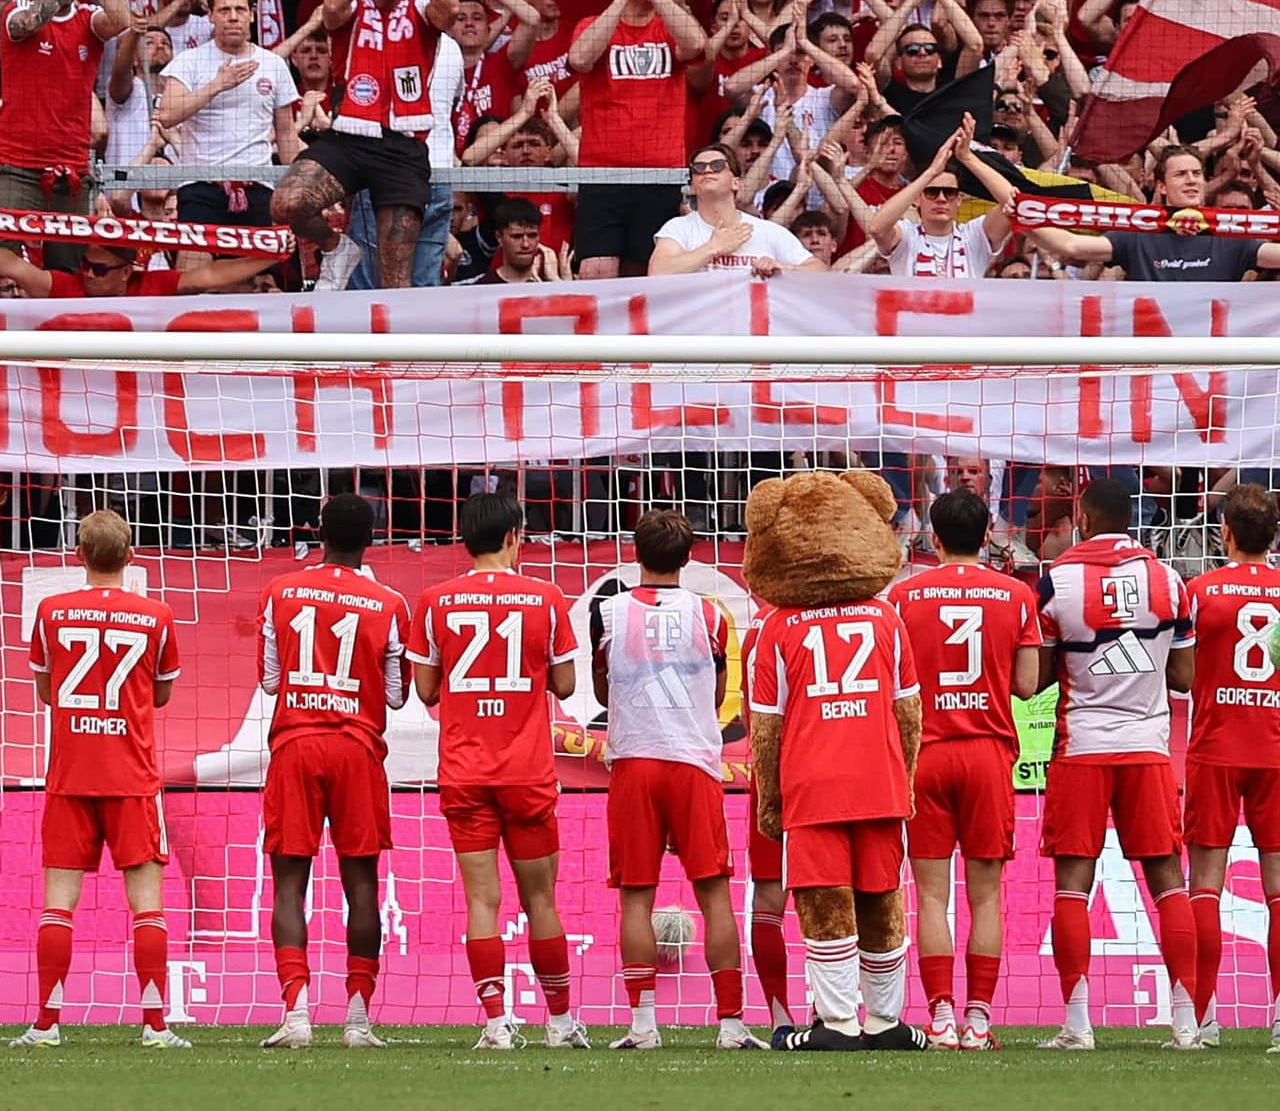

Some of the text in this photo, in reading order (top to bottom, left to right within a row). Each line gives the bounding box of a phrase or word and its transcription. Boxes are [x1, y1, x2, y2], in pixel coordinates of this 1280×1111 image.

[1016, 200, 1162, 231] SCHIC
[708, 254, 758, 267] KURVE
[498, 280, 975, 442] ALLE
[1078, 295, 1228, 444] IN
[282, 588, 384, 612] FC BAYERN MÜNCHEN
[439, 592, 543, 607] FC BAYERN MÜNCHEN
[908, 587, 1011, 602] FC BAYERN MÜNCHEN
[1206, 585, 1219, 596] FC
[1222, 583, 1261, 597] BAYERN
[51, 609, 157, 628] FC BAYERN MÜNCHEN
[786, 604, 883, 627] FC BAYERN MÜNCHEN
[288, 604, 361, 692] 11
[446, 610, 532, 693] 21
[938, 604, 985, 688] 3
[58, 627, 149, 711] 27
[802, 620, 880, 698] 12
[286, 692, 360, 715] N.JACKSON
[477, 699, 505, 717] ITO
[821, 698, 867, 720] BERNI
[934, 692, 990, 712] MINJAE
[70, 716, 127, 736] LAIMER
